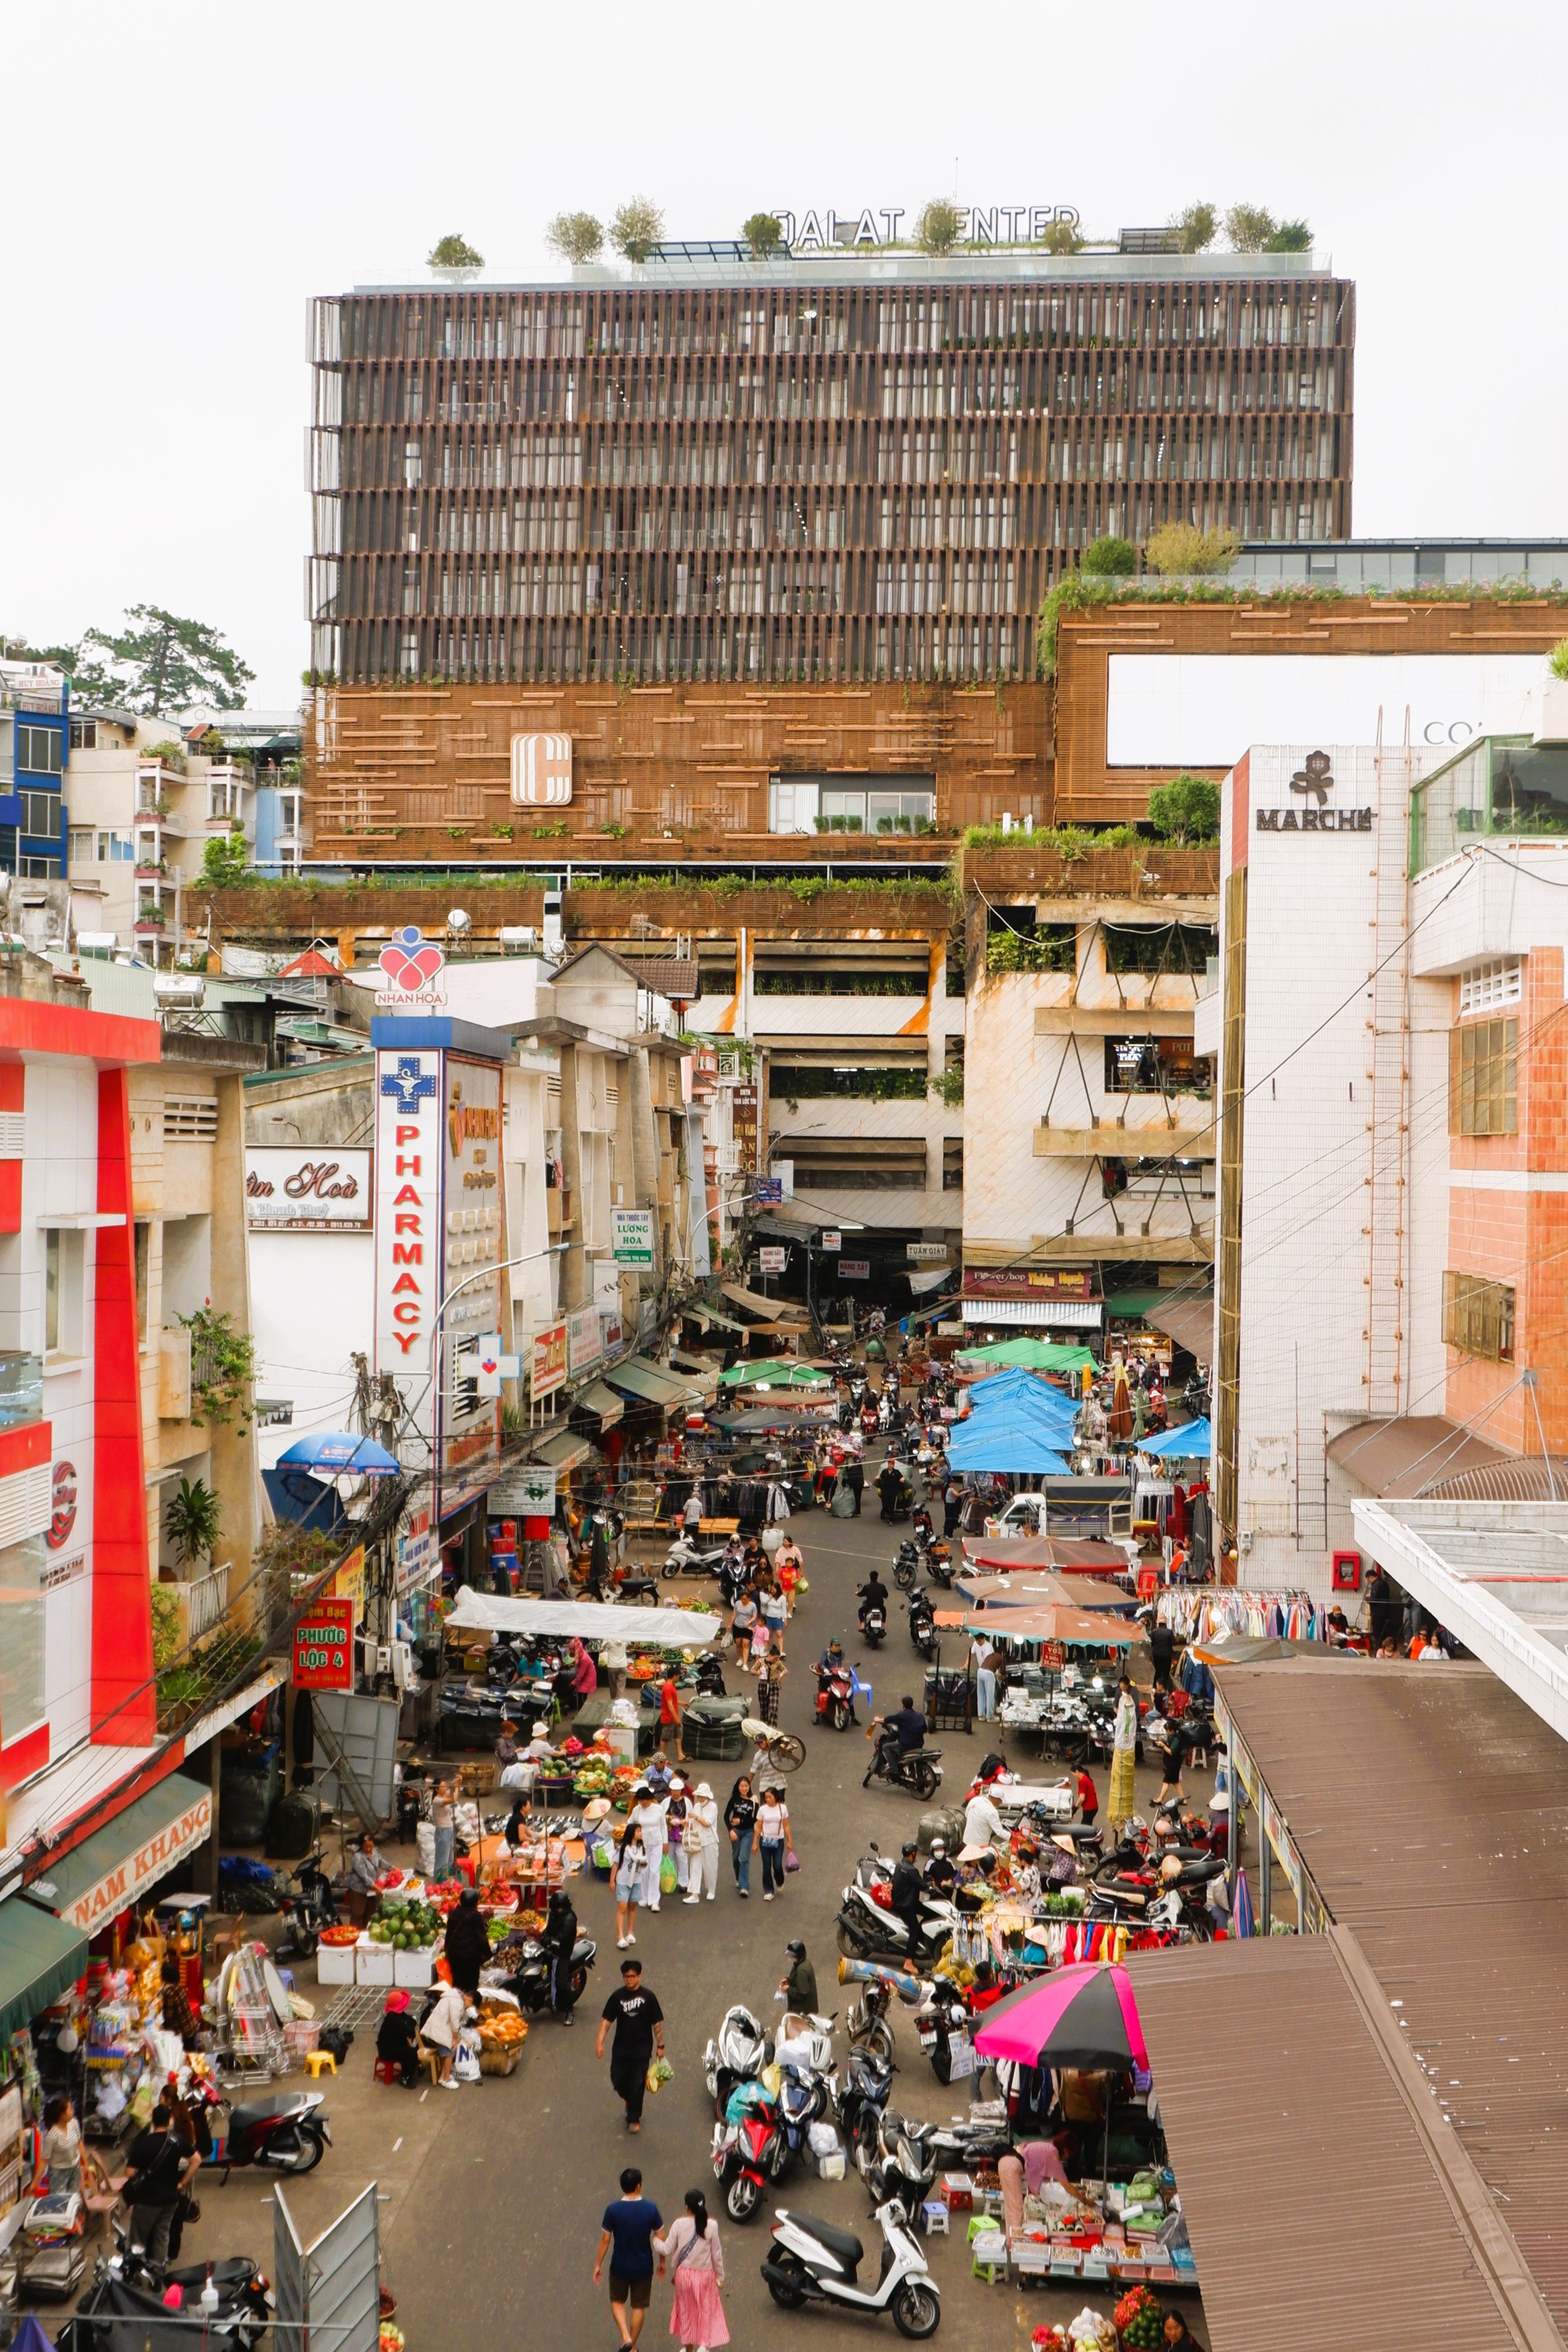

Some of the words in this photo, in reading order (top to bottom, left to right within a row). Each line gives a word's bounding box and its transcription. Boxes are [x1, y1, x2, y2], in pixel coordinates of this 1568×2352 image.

[925, 206, 1081, 246] ENTER
[1423, 721, 1483, 745] CO
[247, 1170, 274, 1197] ân
[391, 1125, 423, 1354] PHARMACY
[623, 1237, 642, 1245] HOA
[327, 1605, 346, 1620] Bạc
[297, 1626, 346, 1645] PHƯỚC
[299, 1648, 328, 1670] LỘC
[332, 1651, 344, 1668] 4
[73, 1866, 128, 1928] NAM
[133, 1800, 211, 1882] KHANG
